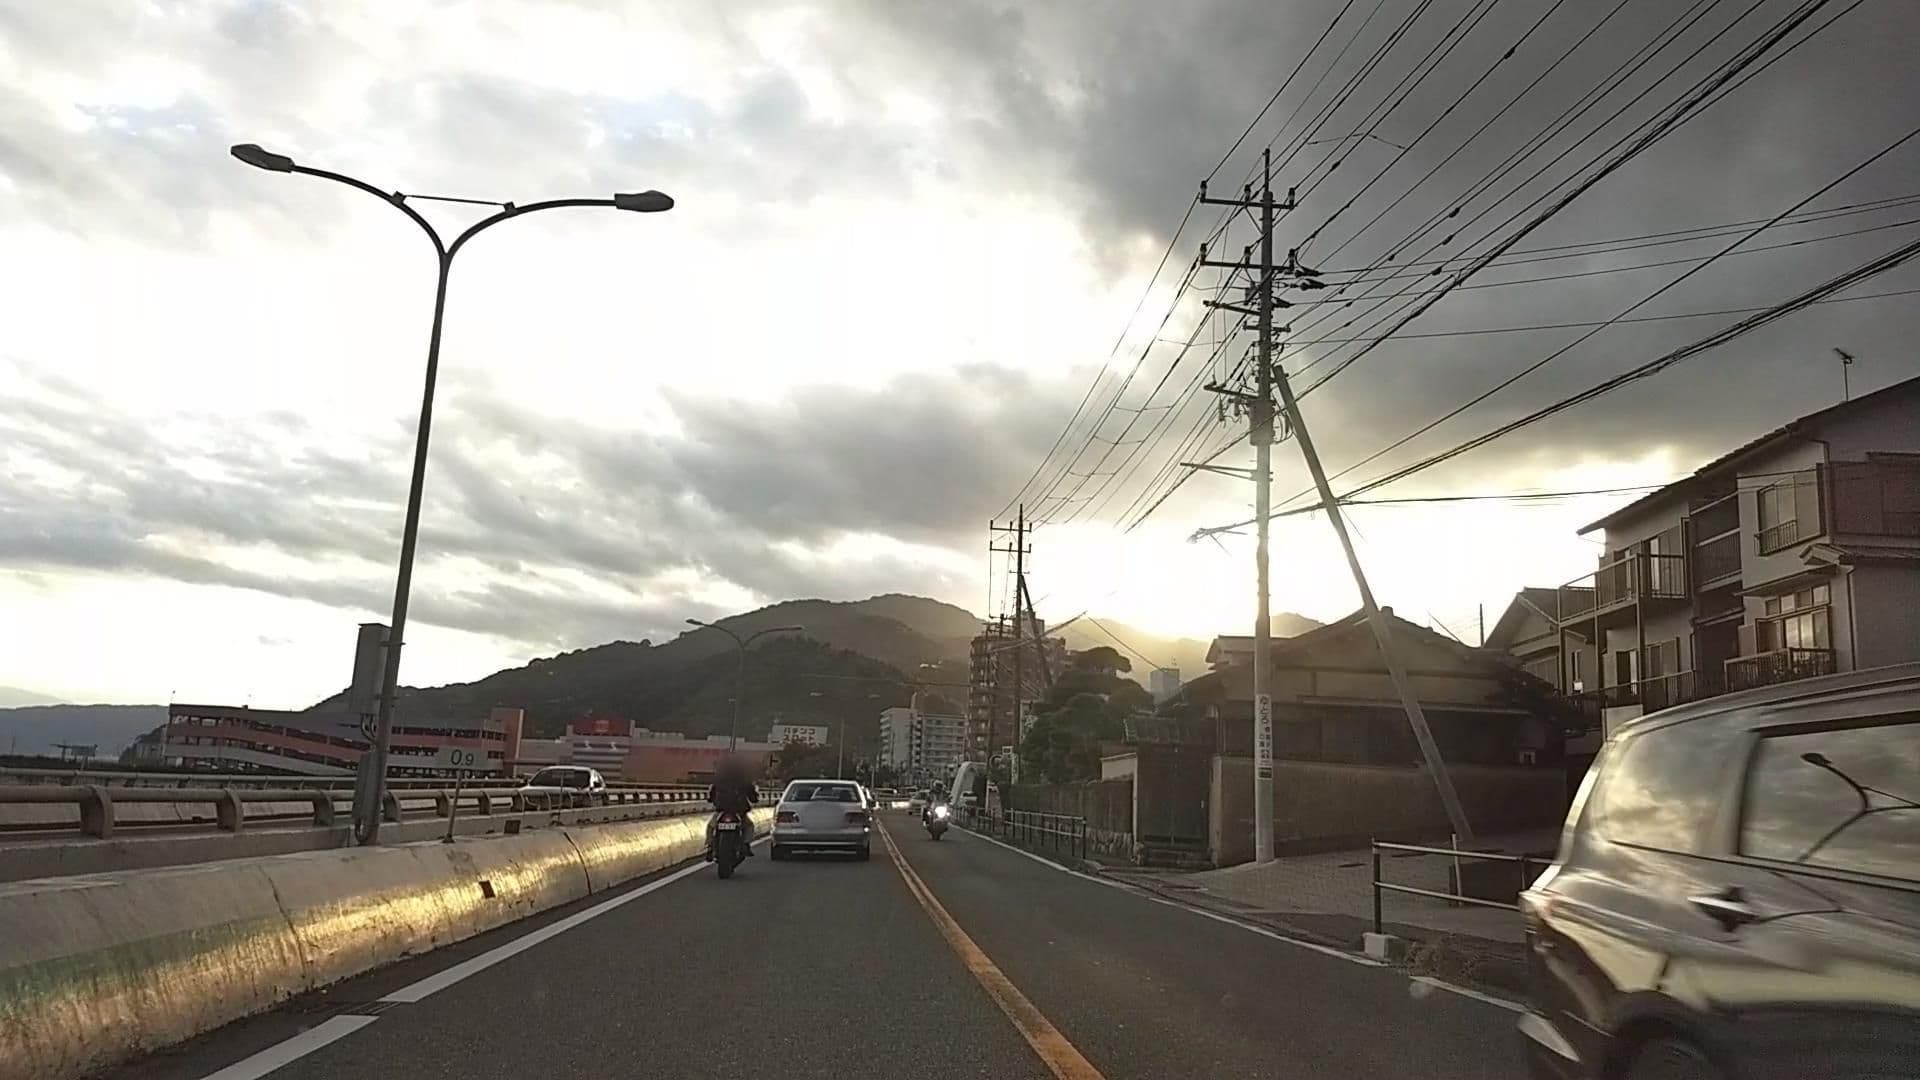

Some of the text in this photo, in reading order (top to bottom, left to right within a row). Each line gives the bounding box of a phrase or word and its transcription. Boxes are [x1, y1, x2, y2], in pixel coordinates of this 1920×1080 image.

[783, 726, 816, 735] パチンコ
[451, 749, 474, 766] 0.9
